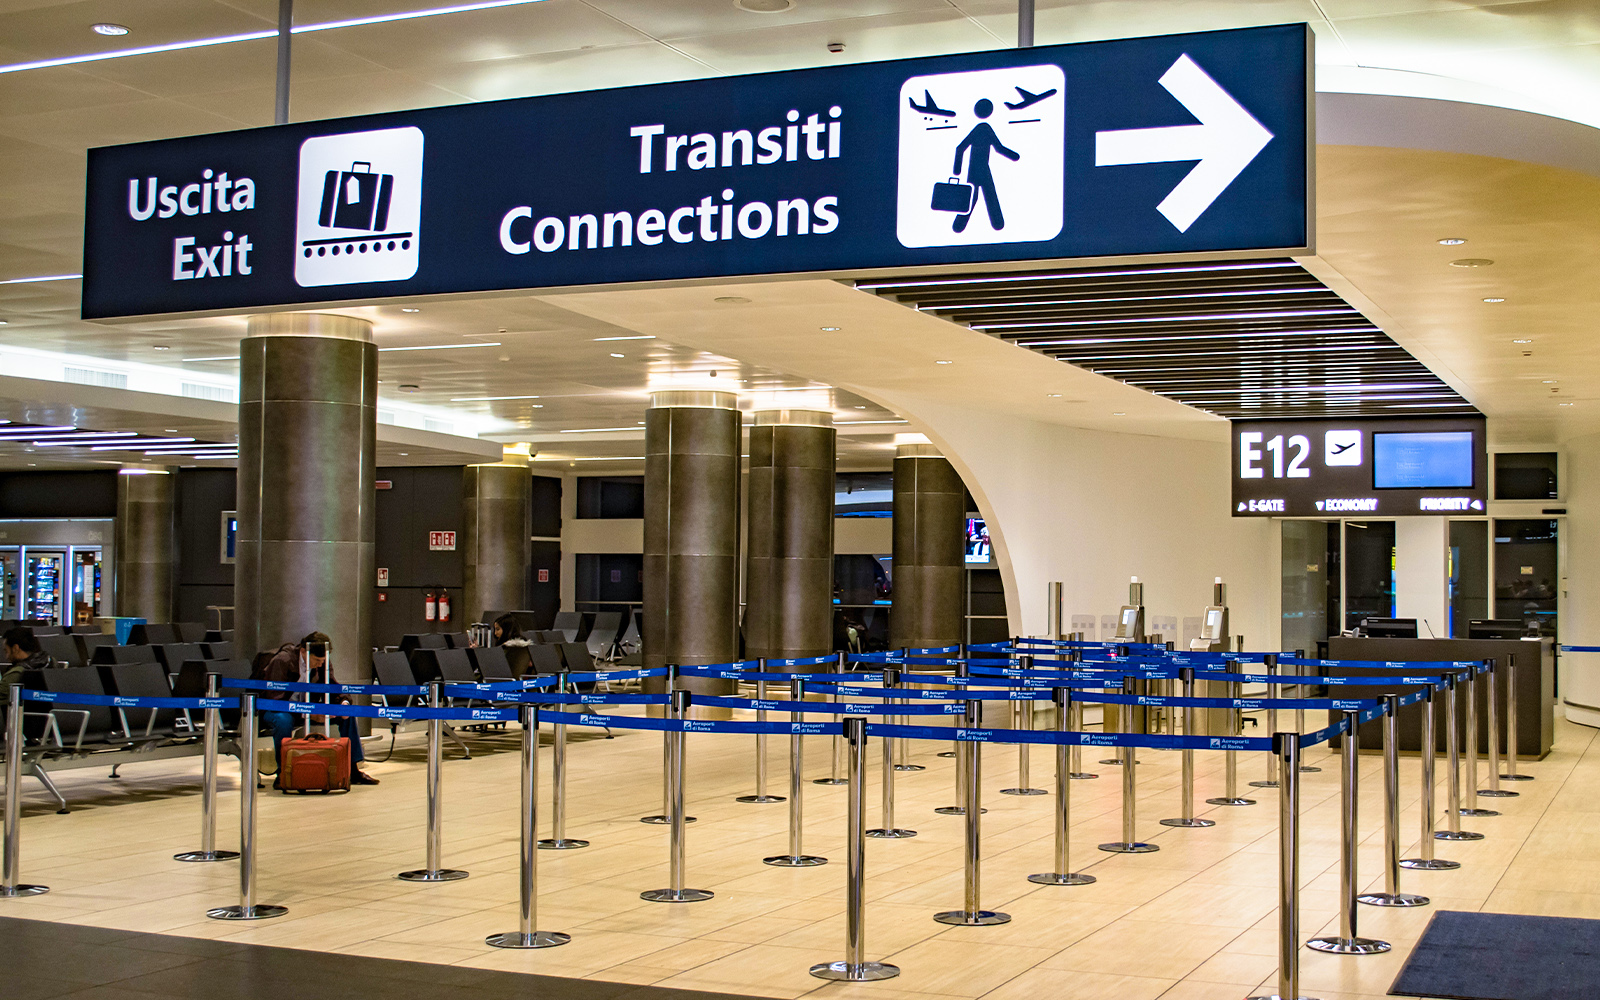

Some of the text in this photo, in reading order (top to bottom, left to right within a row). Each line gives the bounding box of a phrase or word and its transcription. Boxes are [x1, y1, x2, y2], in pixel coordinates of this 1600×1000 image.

[630, 105, 842, 173] Transiti
[128, 169, 255, 221] Uscita
[499, 188, 839, 255] Connections
[172, 231, 253, 281] Exit
[1240, 432, 1310, 479] E12
[1249, 500, 1285, 511] E-GATE
[1325, 499, 1378, 511] ECONOMY
[1420, 498, 1470, 511] PRIORITY
